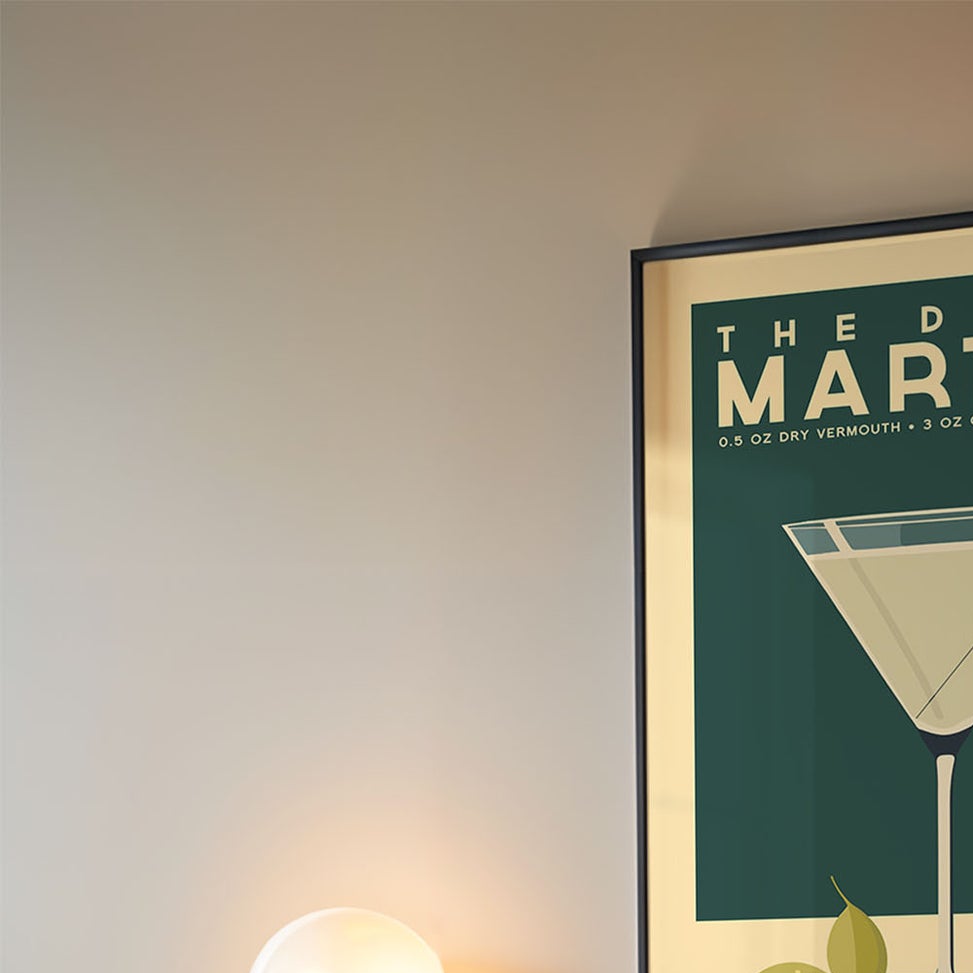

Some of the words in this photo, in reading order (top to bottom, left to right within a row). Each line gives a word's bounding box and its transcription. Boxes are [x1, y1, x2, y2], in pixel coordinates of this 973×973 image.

[716, 313, 857, 353] THE
[718, 435, 743, 448] 0.5
[750, 432, 772, 445] OZ
[779, 429, 810, 443] DRY
[816, 421, 901, 439] VERMOUTH
[923, 418, 932, 430] 3
[940, 416, 962, 429] OZ
